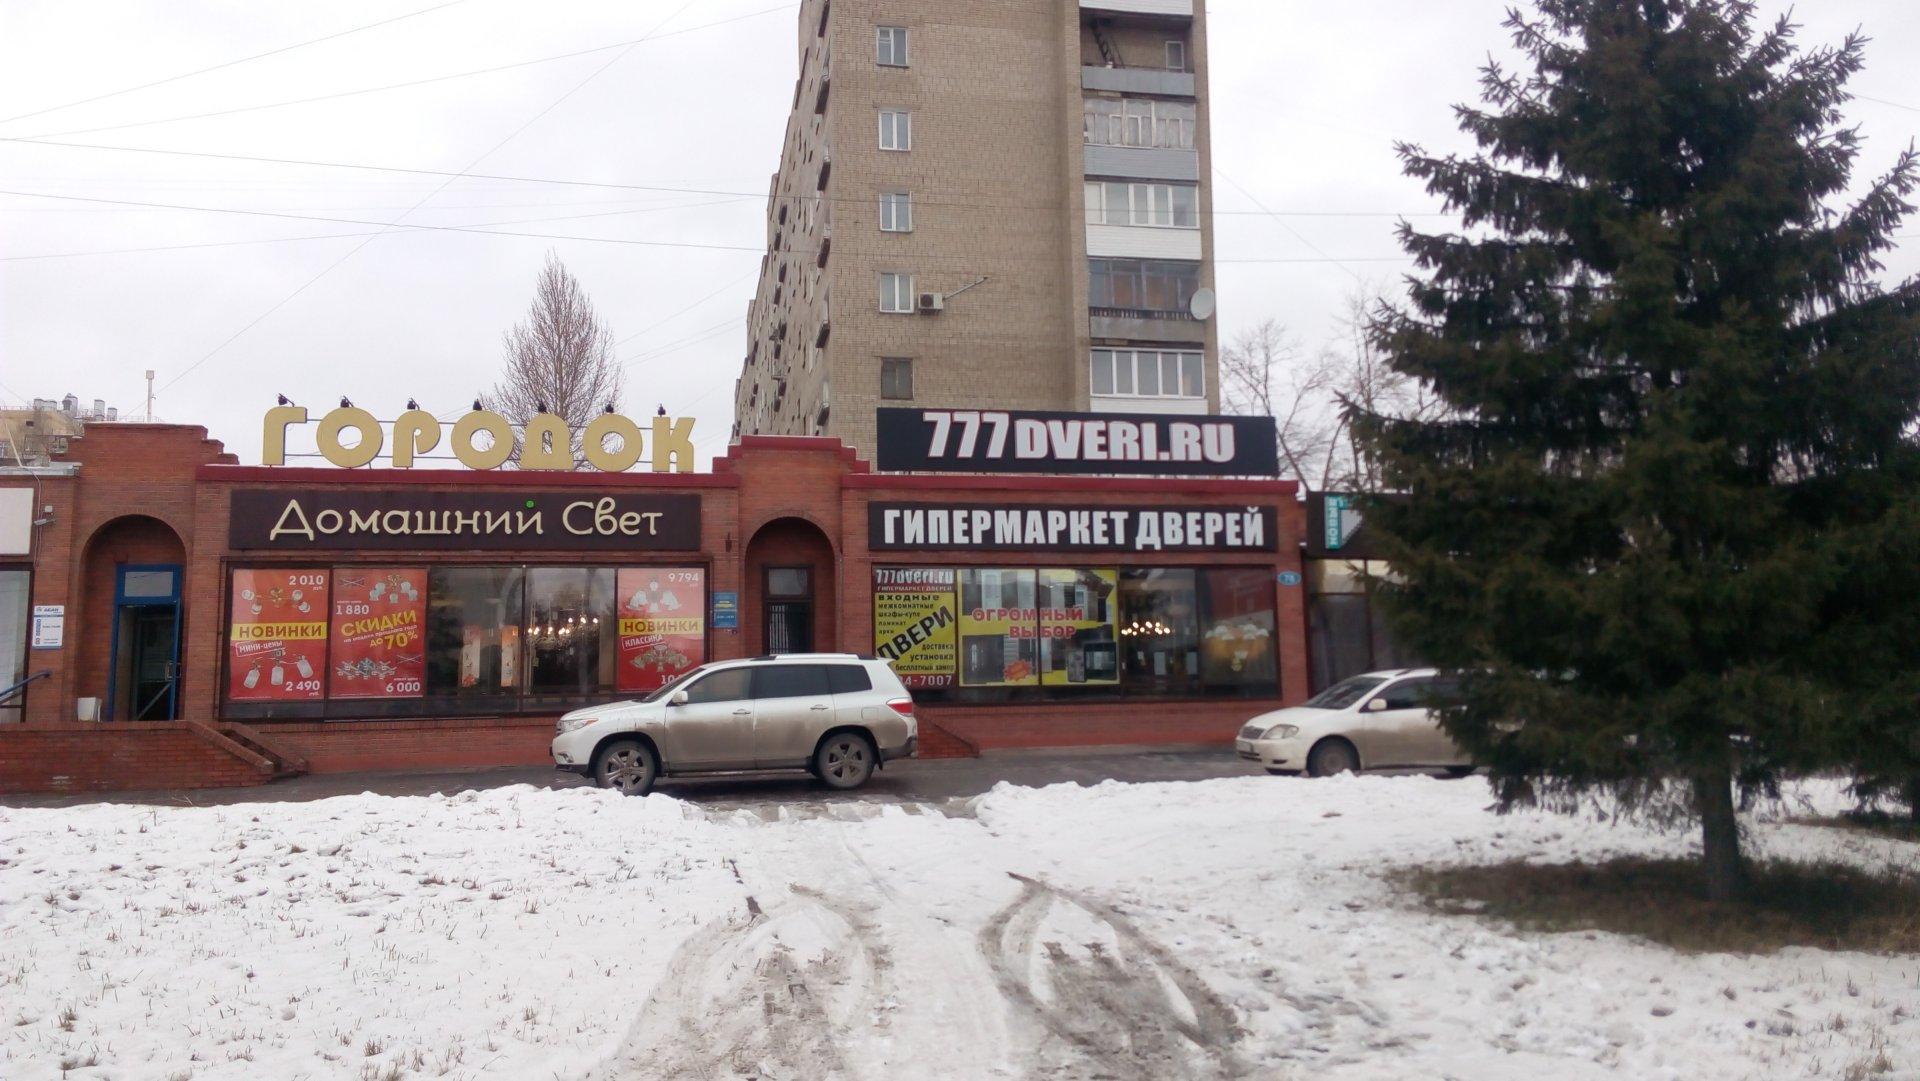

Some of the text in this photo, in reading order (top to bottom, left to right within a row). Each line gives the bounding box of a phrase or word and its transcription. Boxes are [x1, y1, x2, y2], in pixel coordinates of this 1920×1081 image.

[263, 406, 696, 473] ГОРОДОК
[270, 496, 663, 541] Домашний Свет
[883, 506, 1264, 550] ГИПЕРМАРКЕТ ДВЕРЕЙ
[878, 594, 940, 602] входные
[878, 611, 921, 619] шкафы-купе
[972, 605, 1084, 621] ОГРОМНЫЙ
[341, 610, 417, 637] СКИДКИ
[624, 620, 698, 633] НОВИНКИ
[240, 625, 322, 638] НОВИНКИ
[877, 605, 954, 661] ДВЕРИ
[1009, 625, 1077, 638] ВЫБОР
[625, 634, 663, 647] КЛАССИКА
[922, 643, 954, 651] доставка
[910, 653, 954, 662] установка
